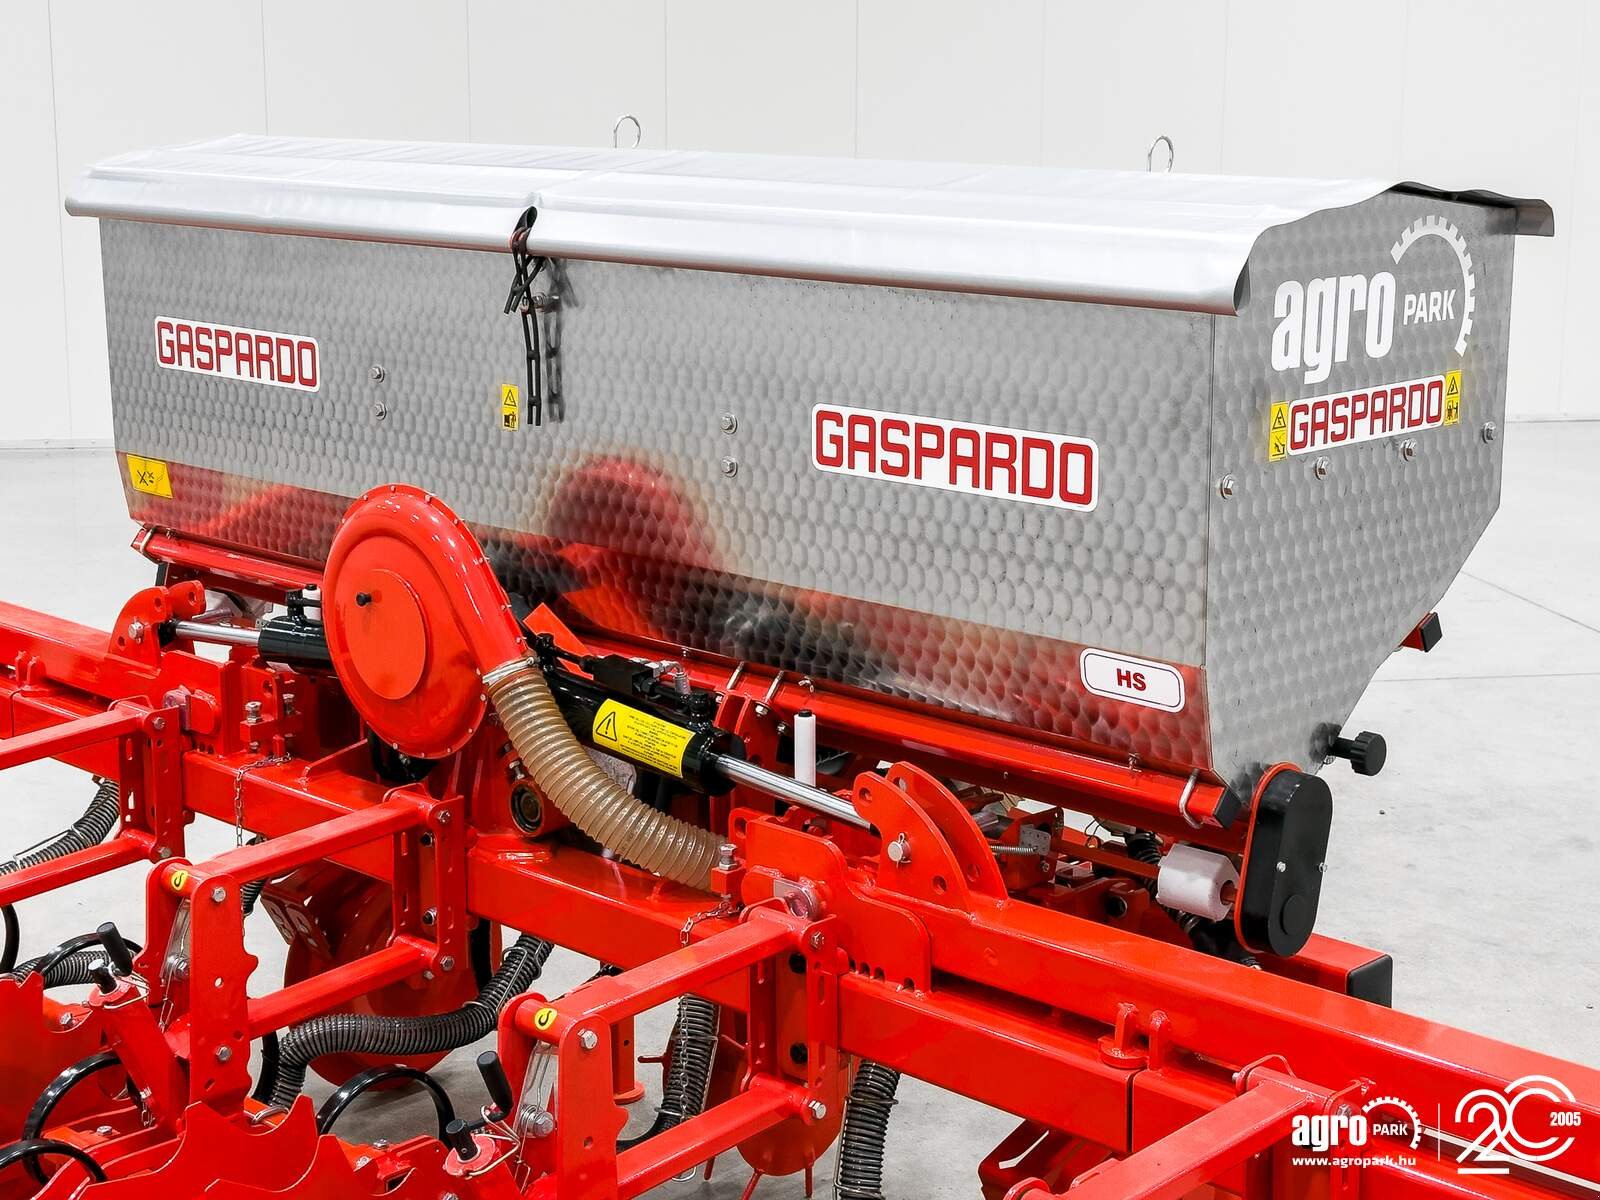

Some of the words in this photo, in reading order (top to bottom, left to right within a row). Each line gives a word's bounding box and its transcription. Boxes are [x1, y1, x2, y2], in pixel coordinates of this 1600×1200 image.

[157, 321, 317, 387] GASPARDO
[1271, 271, 1396, 385] agro
[1403, 289, 1456, 325] PARK
[1290, 380, 1443, 450] GASPARDO
[816, 410, 1093, 505] GASPARDO
[1116, 668, 1147, 691] HS
